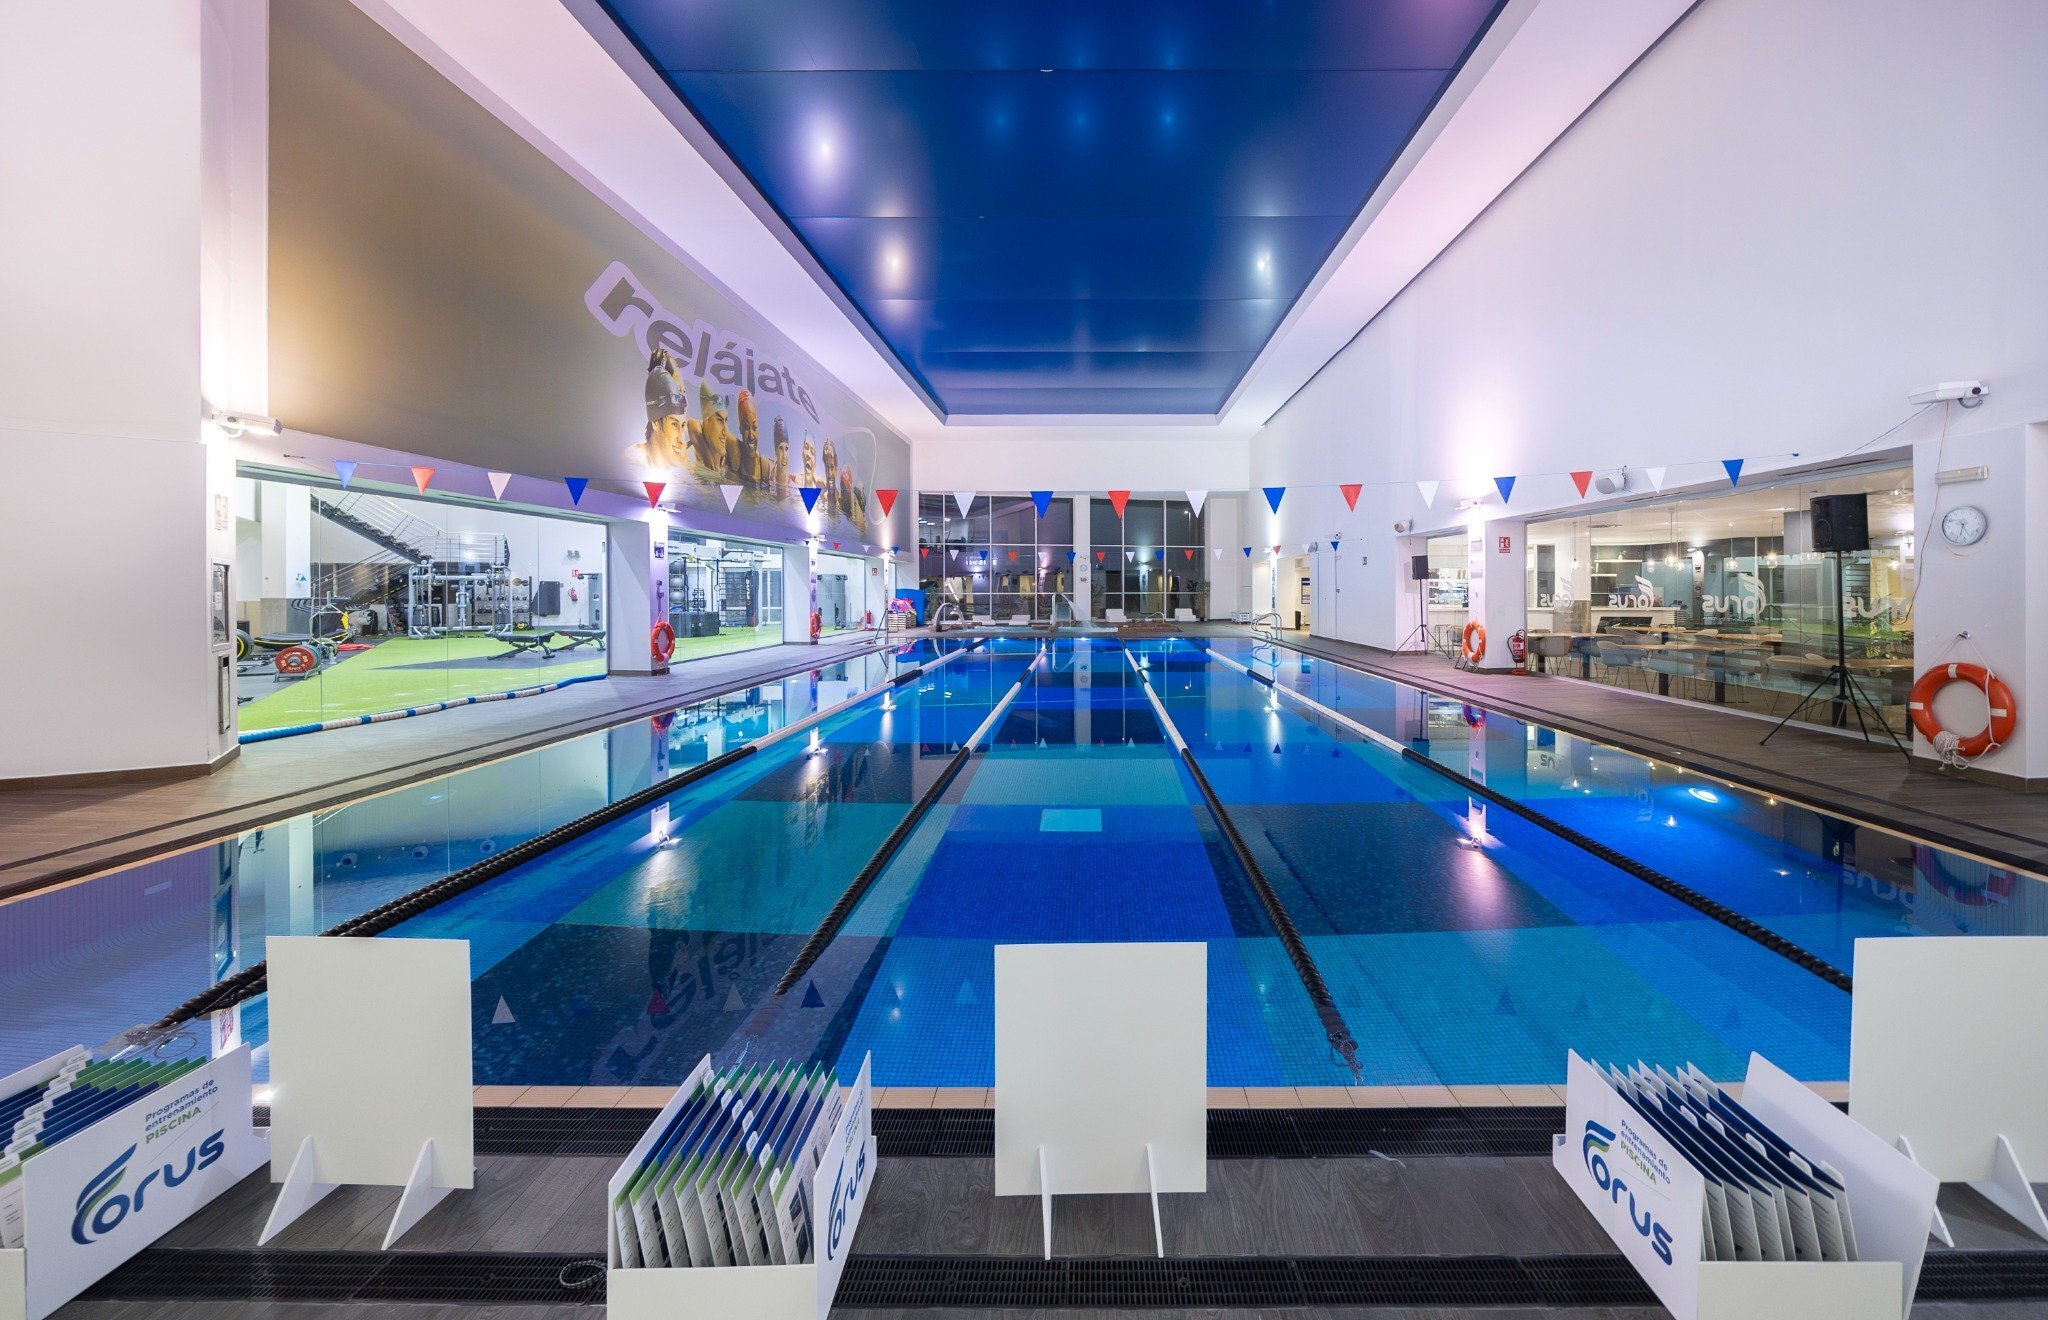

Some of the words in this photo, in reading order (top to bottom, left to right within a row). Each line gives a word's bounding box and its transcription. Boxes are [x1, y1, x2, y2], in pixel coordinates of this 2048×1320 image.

[599, 276, 820, 424] relájate
[145, 1088, 199, 1122] Programas
[202, 1080, 214, 1090] de
[145, 1086, 218, 1131] entrenamiento
[146, 1106, 202, 1144] PISCINA
[1621, 1119, 1657, 1161] Programas
[1658, 1155, 1668, 1171] de
[1620, 1130, 1671, 1184] entrenamiento
[1620, 1140, 1656, 1184] PISCINA
